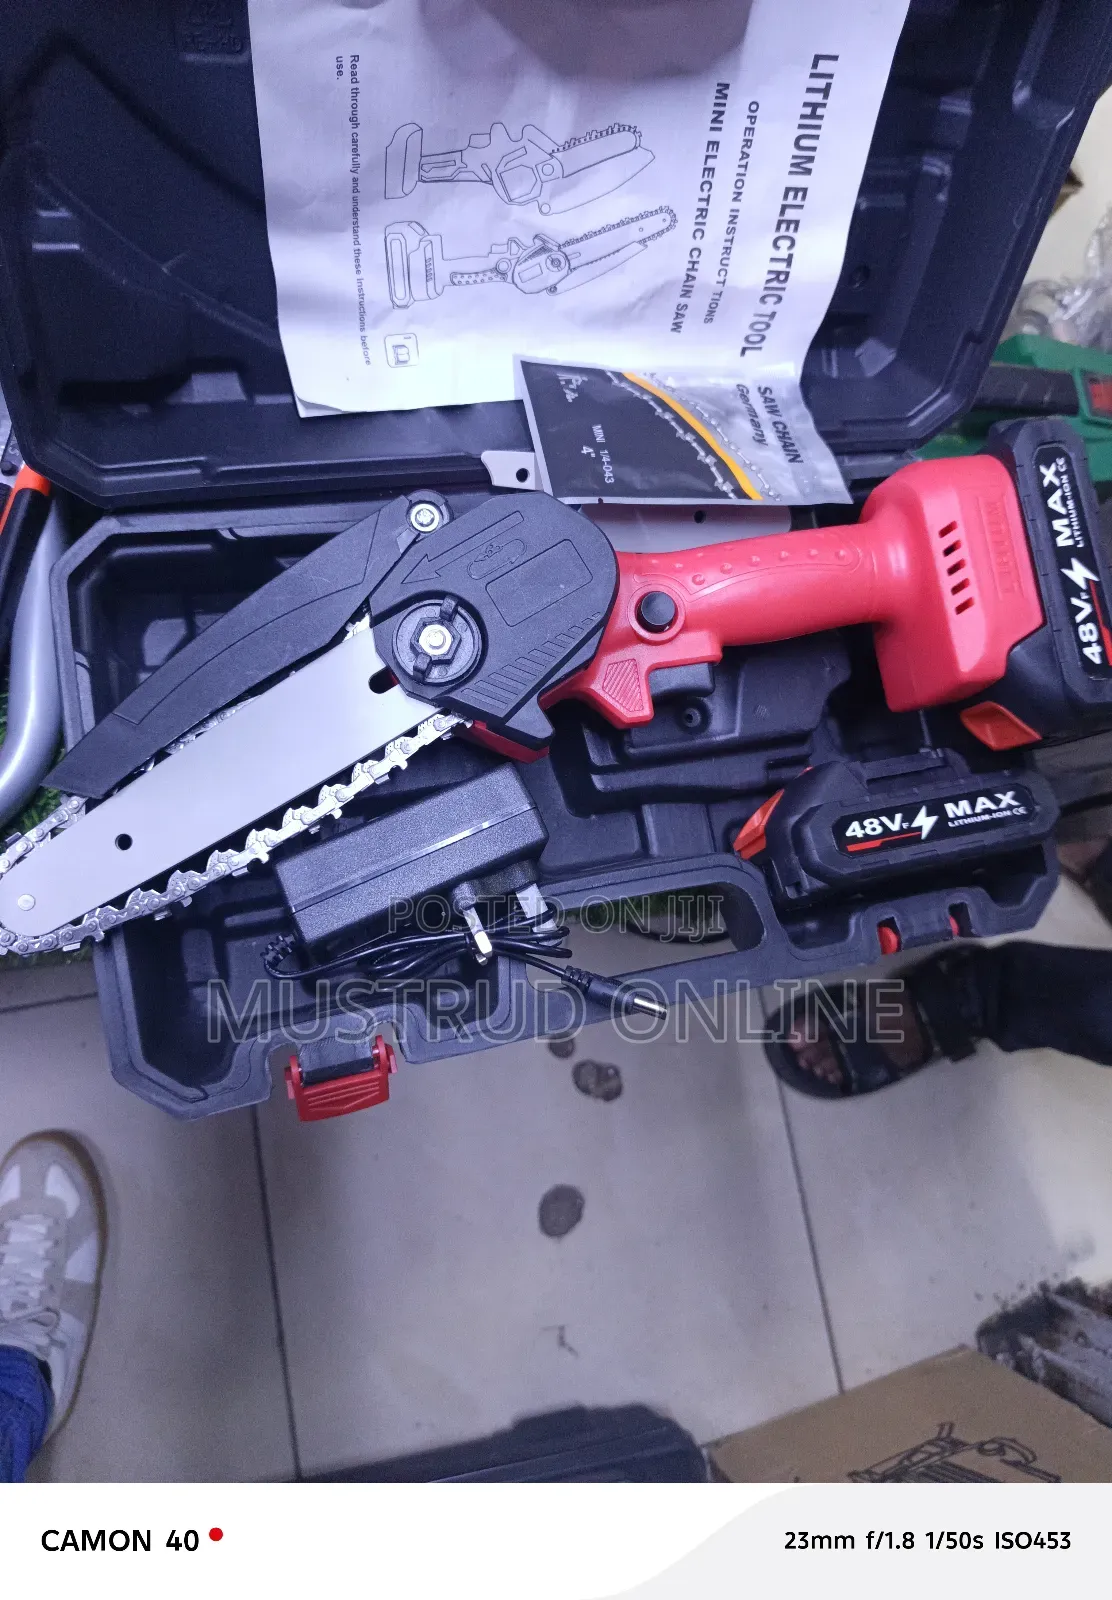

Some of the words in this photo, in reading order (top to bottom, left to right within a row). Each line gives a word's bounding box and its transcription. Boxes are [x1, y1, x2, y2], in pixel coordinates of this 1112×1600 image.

[335, 55, 344, 80] use.
[350, 54, 360, 84] Read
[349, 87, 361, 129] through
[709, 82, 731, 132] MINI
[787, 54, 840, 176] LITHIUM
[350, 131, 361, 175] carefully
[731, 100, 760, 203] OPERATION
[352, 176, 361, 194] and
[691, 140, 720, 241] ELECTRIC
[351, 195, 362, 246] understand
[353, 248, 362, 275] these
[715, 208, 740, 287] INSTRUCT
[758, 186, 809, 306] ELECTRIC
[679, 247, 702, 298] CHAIN
[670, 302, 689, 334] SAW
[703, 291, 723, 324] TIONS
[360, 335, 371, 366] before
[739, 311, 777, 358] TOOL
[736, 383, 769, 447] Germany
[757, 385, 782, 418] SAW
[772, 420, 804, 464] CHAIN
[591, 423, 606, 443] MINI
[600, 448, 615, 484] 1/4-043
[1039, 462, 1075, 548] MAX
[1060, 474, 1085, 548] LITHIUM-ION
[943, 790, 1021, 819] MAX
[947, 809, 1012, 828] LITHIUM-ION
